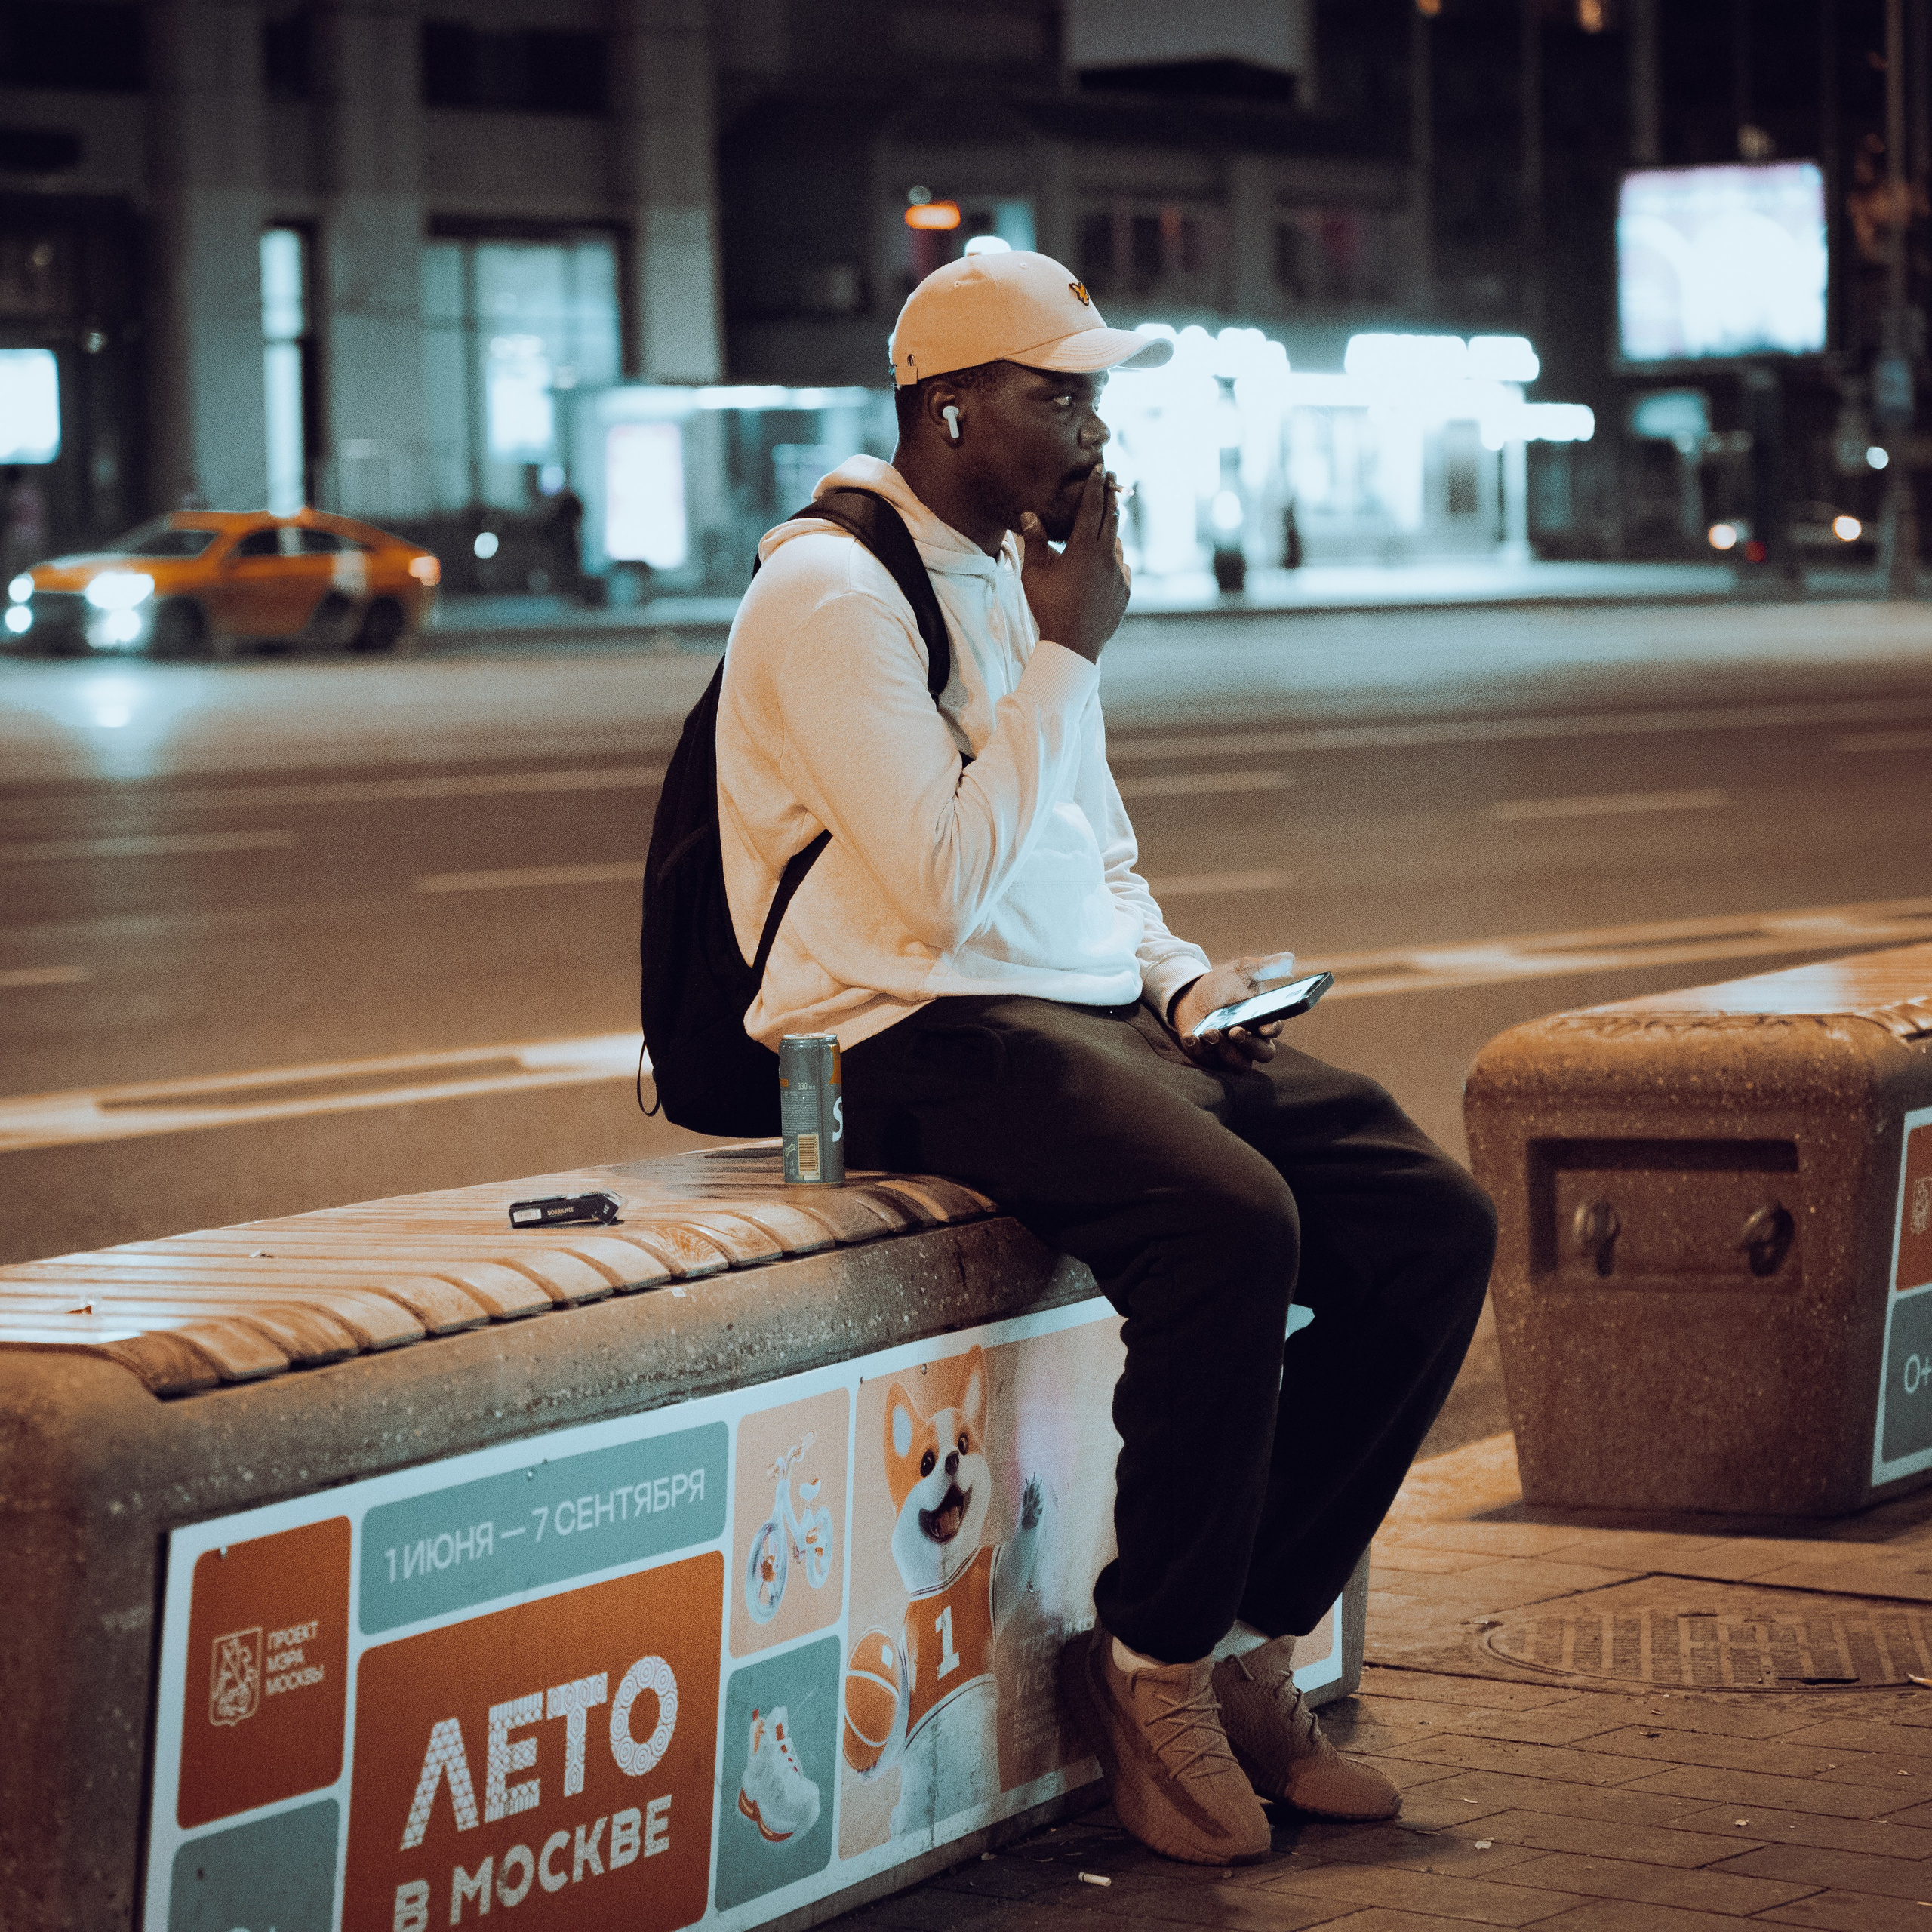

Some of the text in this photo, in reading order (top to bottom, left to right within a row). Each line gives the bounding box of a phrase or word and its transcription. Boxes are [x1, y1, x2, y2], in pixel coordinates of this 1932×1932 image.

[797, 1082, 808, 1091] 330
[385, 1548, 397, 1583] 1
[402, 1521, 494, 1580] ИЮНЯ
[531, 1507, 549, 1543] 7
[555, 1468, 706, 1536] СЕНТЯБРЯ
[267, 1648, 304, 1672] МЭРА
[268, 1620, 318, 1650] ПРОЕКТ
[935, 1605, 960, 1681] 1
[266, 1663, 325, 1695] МОСКВЫ
[400, 1655, 678, 1851] ЛЕТО
[393, 1794, 672, 1932] В МОСКВЕ
